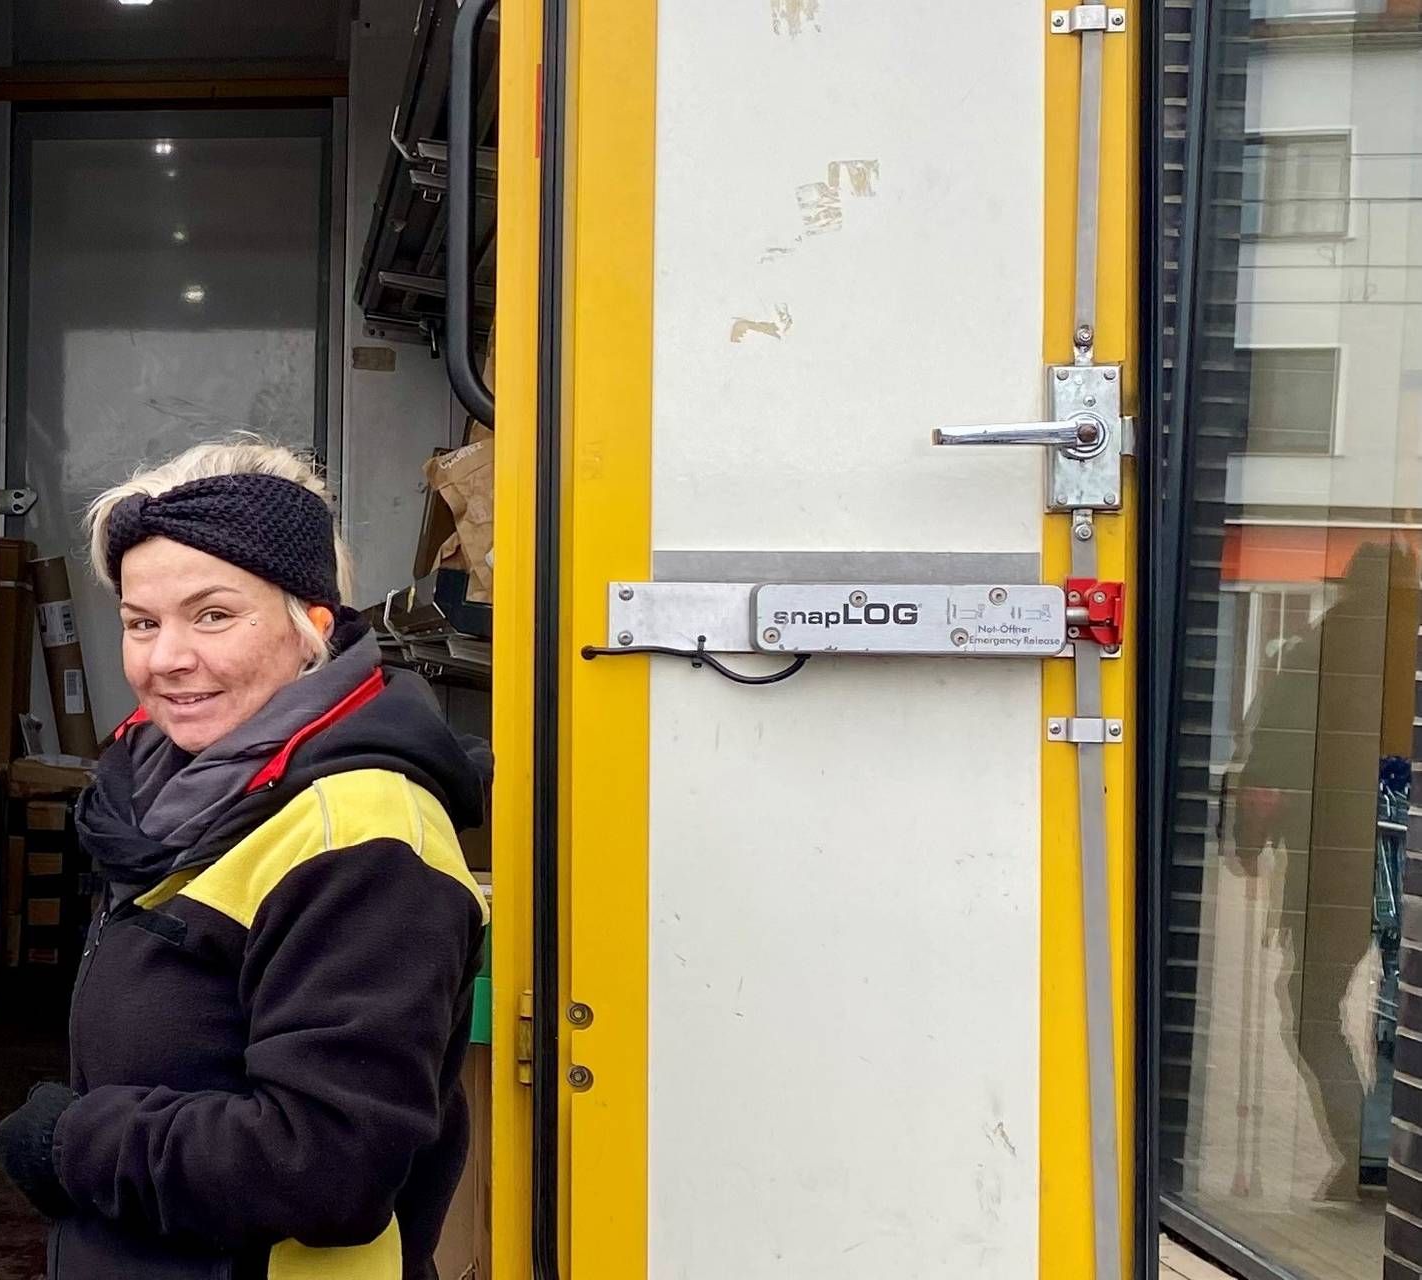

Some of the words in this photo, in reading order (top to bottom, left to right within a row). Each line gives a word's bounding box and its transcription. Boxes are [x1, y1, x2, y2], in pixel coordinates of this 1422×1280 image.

[773, 603, 919, 629] snapLOG
[969, 636, 1022, 646] Emergency
[1023, 636, 1061, 645] Release
